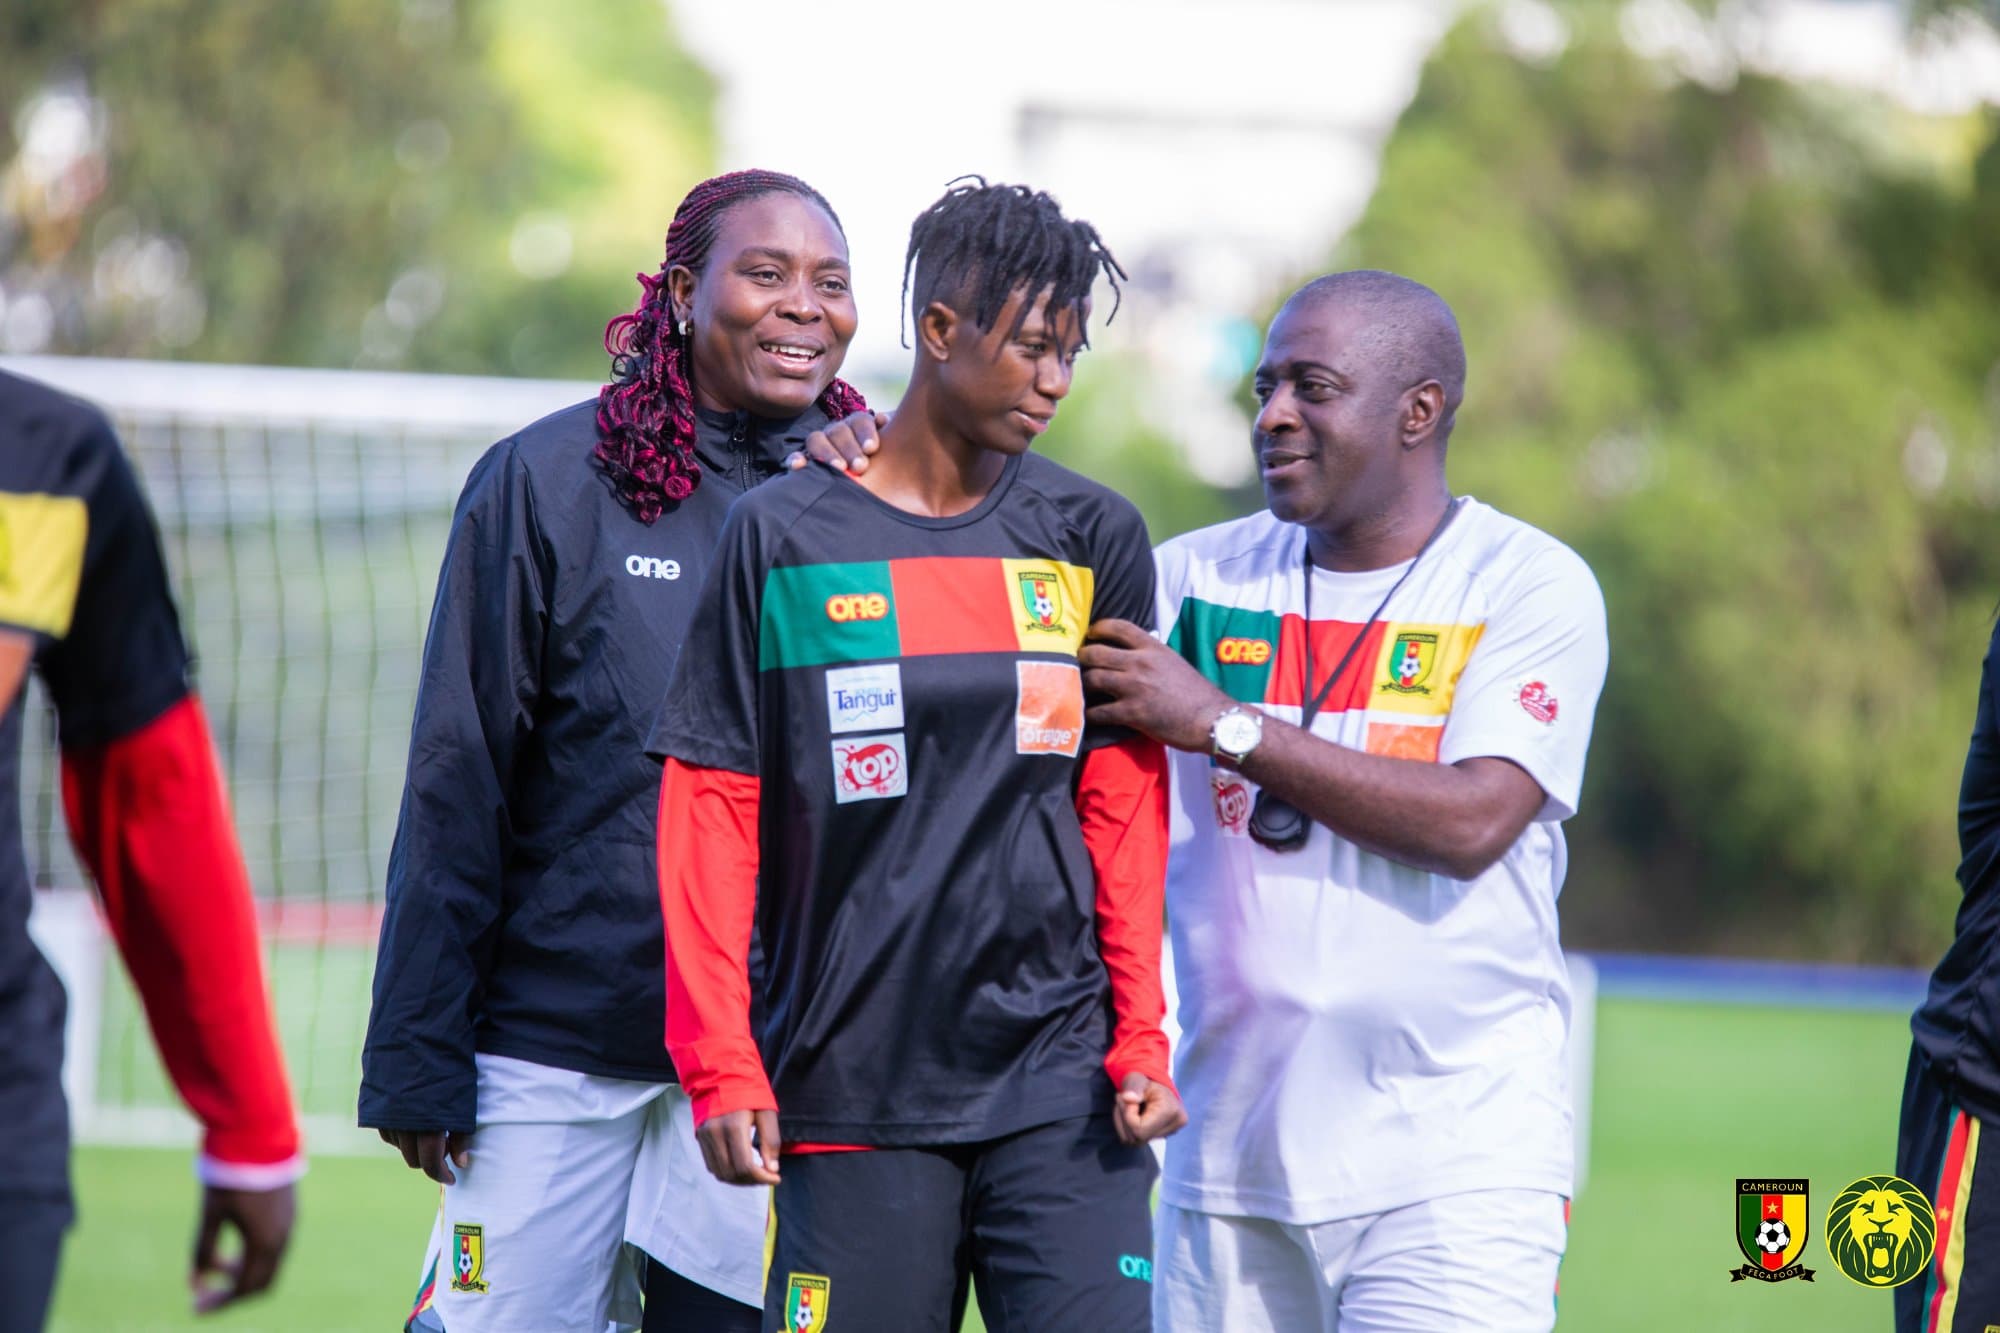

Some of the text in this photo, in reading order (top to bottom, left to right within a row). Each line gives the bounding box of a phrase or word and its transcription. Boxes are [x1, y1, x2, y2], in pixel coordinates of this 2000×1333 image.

[625, 554, 681, 580] one
[827, 594, 888, 620] one
[1219, 639, 1270, 663] one
[833, 688, 896, 712] Tangui
[1119, 1254, 1152, 1283] on
